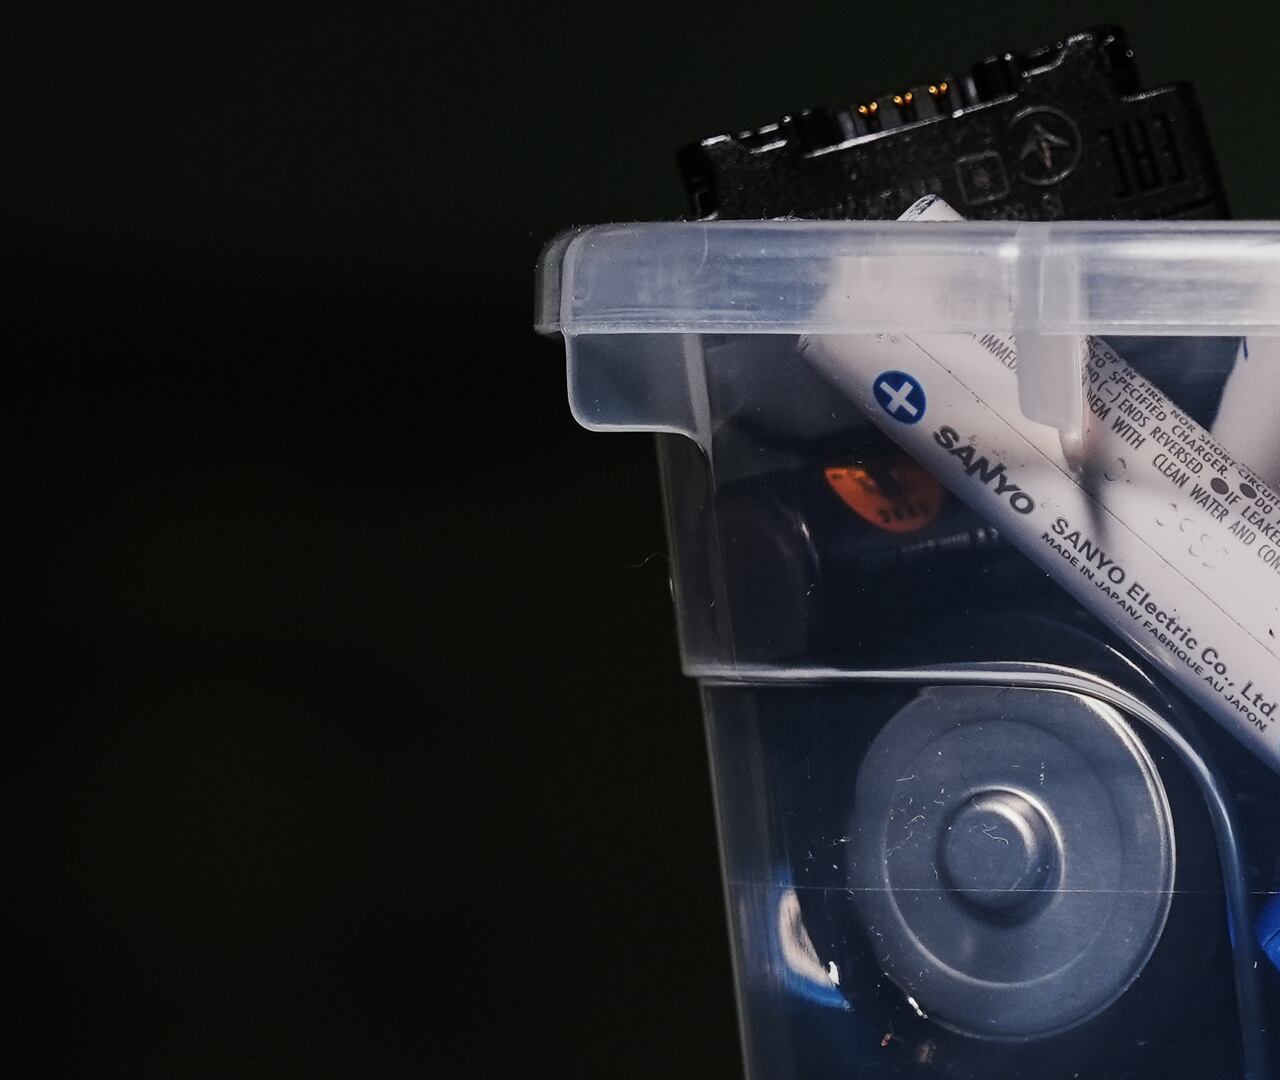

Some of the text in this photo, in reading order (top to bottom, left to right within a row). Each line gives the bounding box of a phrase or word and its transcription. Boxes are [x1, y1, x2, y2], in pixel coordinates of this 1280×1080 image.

[931, 421, 1039, 518] SANYO
[1106, 368, 1171, 425] SPECIFIED
[1168, 422, 1235, 481] CHARGER.
[1253, 495, 1276, 518] DO
[1109, 415, 1147, 451] WITH
[1149, 451, 1191, 489] CLEAN
[1186, 482, 1232, 525] WATER
[1227, 518, 1258, 548] AND
[1114, 396, 1153, 432] ENDS
[1148, 425, 1209, 479] REVERSED.
[1222, 489, 1242, 509] IF
[1040, 532, 1078, 565] MADE
[1075, 562, 1095, 581] IN
[1140, 619, 1205, 676] FABRIQUE
[1202, 673, 1225, 693] AU
[1221, 691, 1269, 732] JAPON
[1048, 515, 1129, 587] SANYO
[1124, 580, 1203, 651] Electric
[1196, 644, 1244, 689] Co.,
